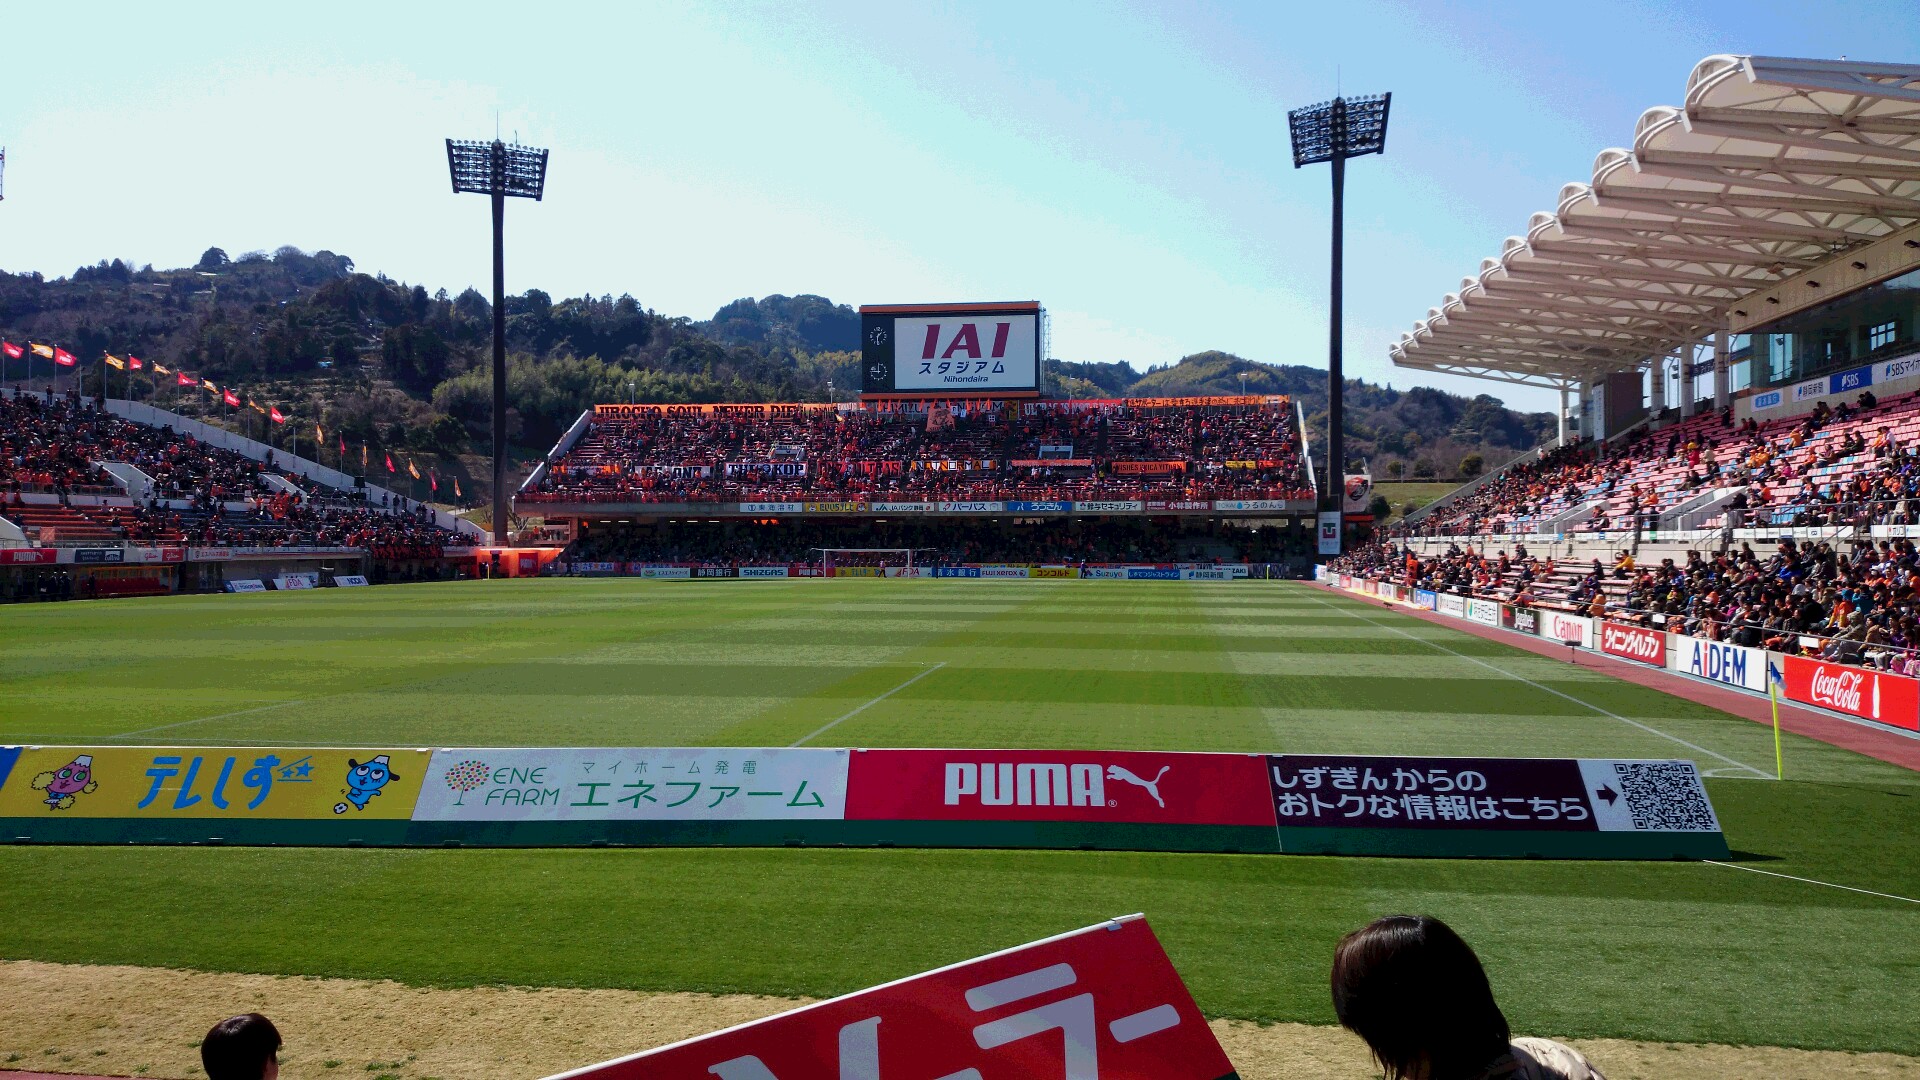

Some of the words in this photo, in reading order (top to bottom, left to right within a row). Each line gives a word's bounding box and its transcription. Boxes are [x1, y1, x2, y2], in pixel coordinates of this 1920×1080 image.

[922, 322, 1011, 359] IAI
[919, 361, 1005, 375] スタジアム
[943, 375, 989, 384] Nihondaira
[1846, 373, 1859, 387] SBS
[770, 405, 797, 419] DIE
[774, 463, 804, 477] KOP
[952, 503, 986, 511] パーパス
[1087, 502, 1138, 511] 鈴与セキュリティ
[1168, 501, 1209, 510] 小林製作所
[13, 552, 36, 562] PUMA
[697, 568, 732, 577] 静岡銀行
[902, 567, 920, 576] FDA
[1037, 568, 1070, 577] コンコルド
[1095, 569, 1123, 578] Suzuyo
[1553, 615, 1583, 641] Canon
[1811, 665, 1864, 712] Coca-Cola
[581, 760, 758, 775] マイホーム発電
[138, 754, 281, 811] テレしず
[492, 767, 548, 785] ENE
[1272, 765, 1487, 792] しずぎんからの
[944, 762, 1106, 807] PUMA
[484, 788, 560, 806] FARM
[569, 780, 826, 809] エネファーム
[1277, 793, 1589, 822] おトクな情報はこちら
